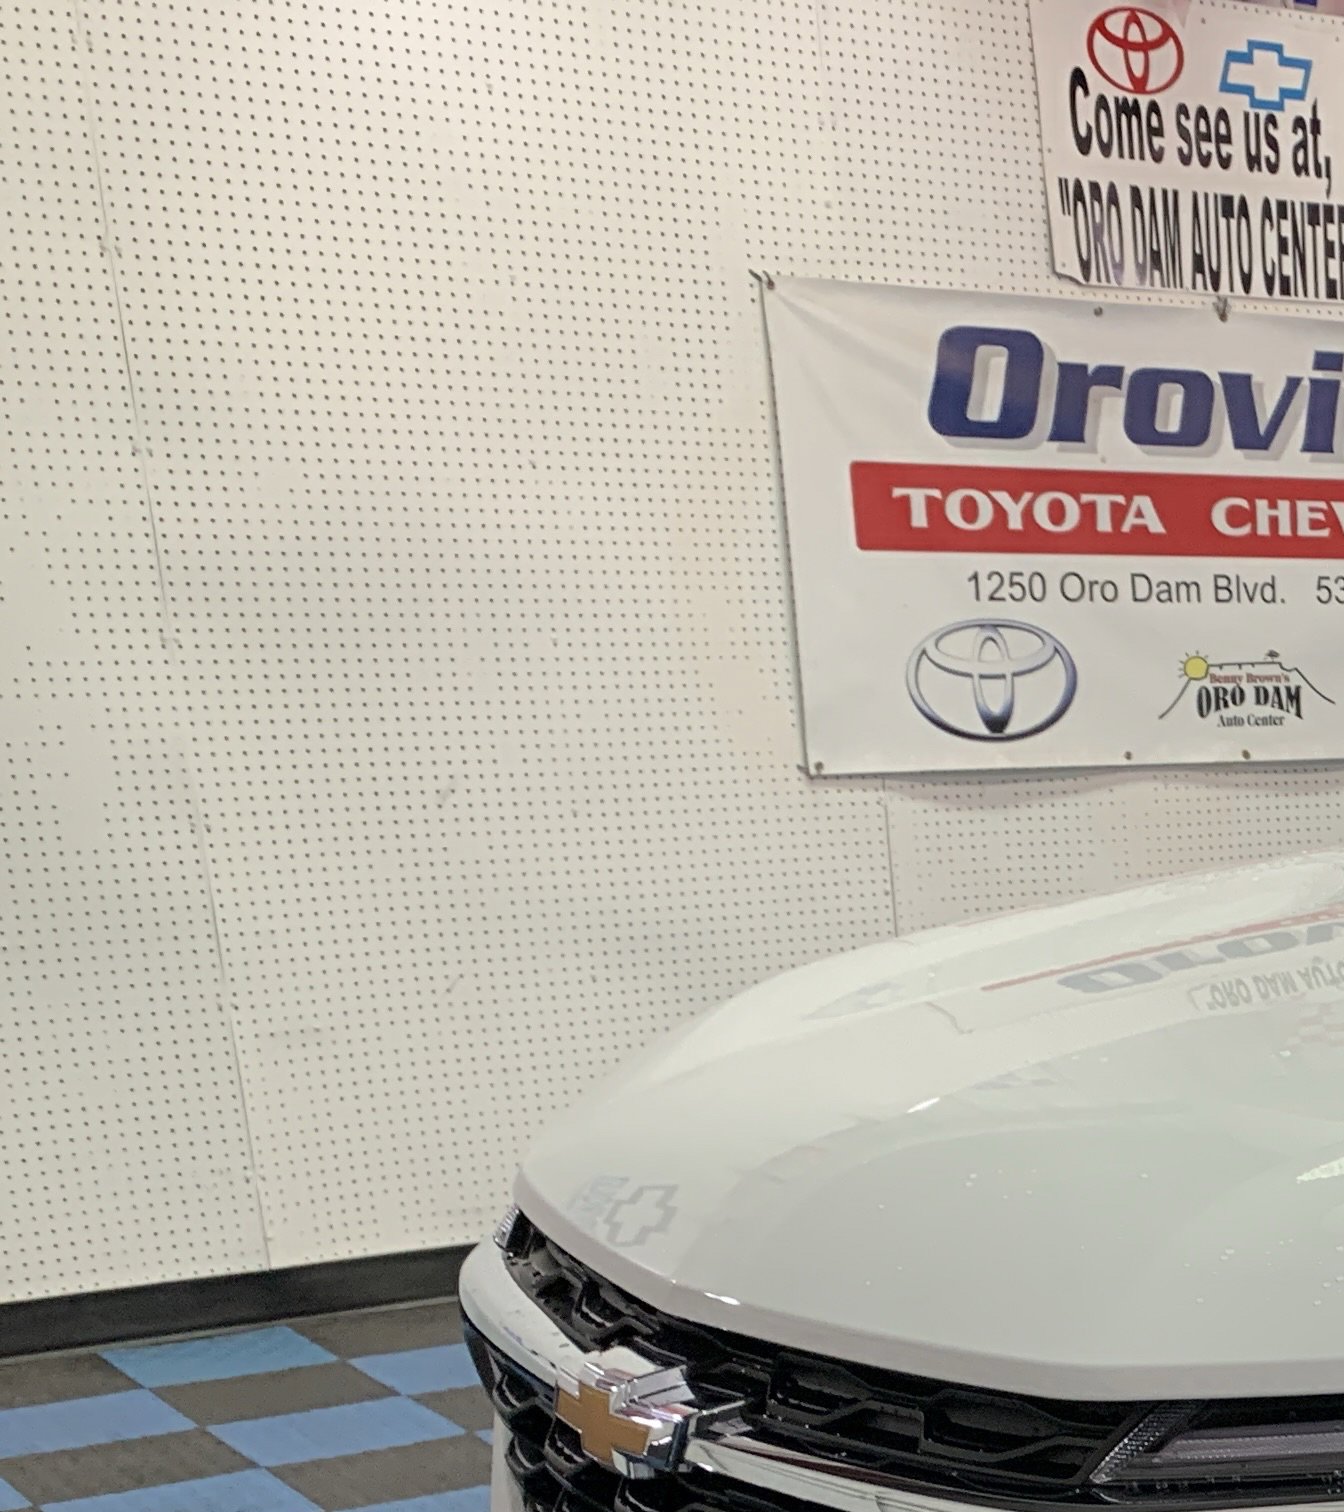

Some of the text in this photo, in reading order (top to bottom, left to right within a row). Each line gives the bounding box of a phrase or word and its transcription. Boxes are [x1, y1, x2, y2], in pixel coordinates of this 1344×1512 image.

[1069, 66, 1332, 199] Come see us at,
[1058, 176, 1125, 285] "ORO
[1129, 184, 1184, 289] DAM
[1191, 191, 1252, 296] AUTO
[892, 487, 1167, 536] TOYOTA
[967, 571, 1047, 604] 1250
[1059, 571, 1119, 605] Oro
[1131, 573, 1201, 605] Dam
[1214, 573, 1287, 606] Blvd.
[1196, 684, 1304, 721] ORO DAM
[1217, 713, 1286, 727] Auto Center
